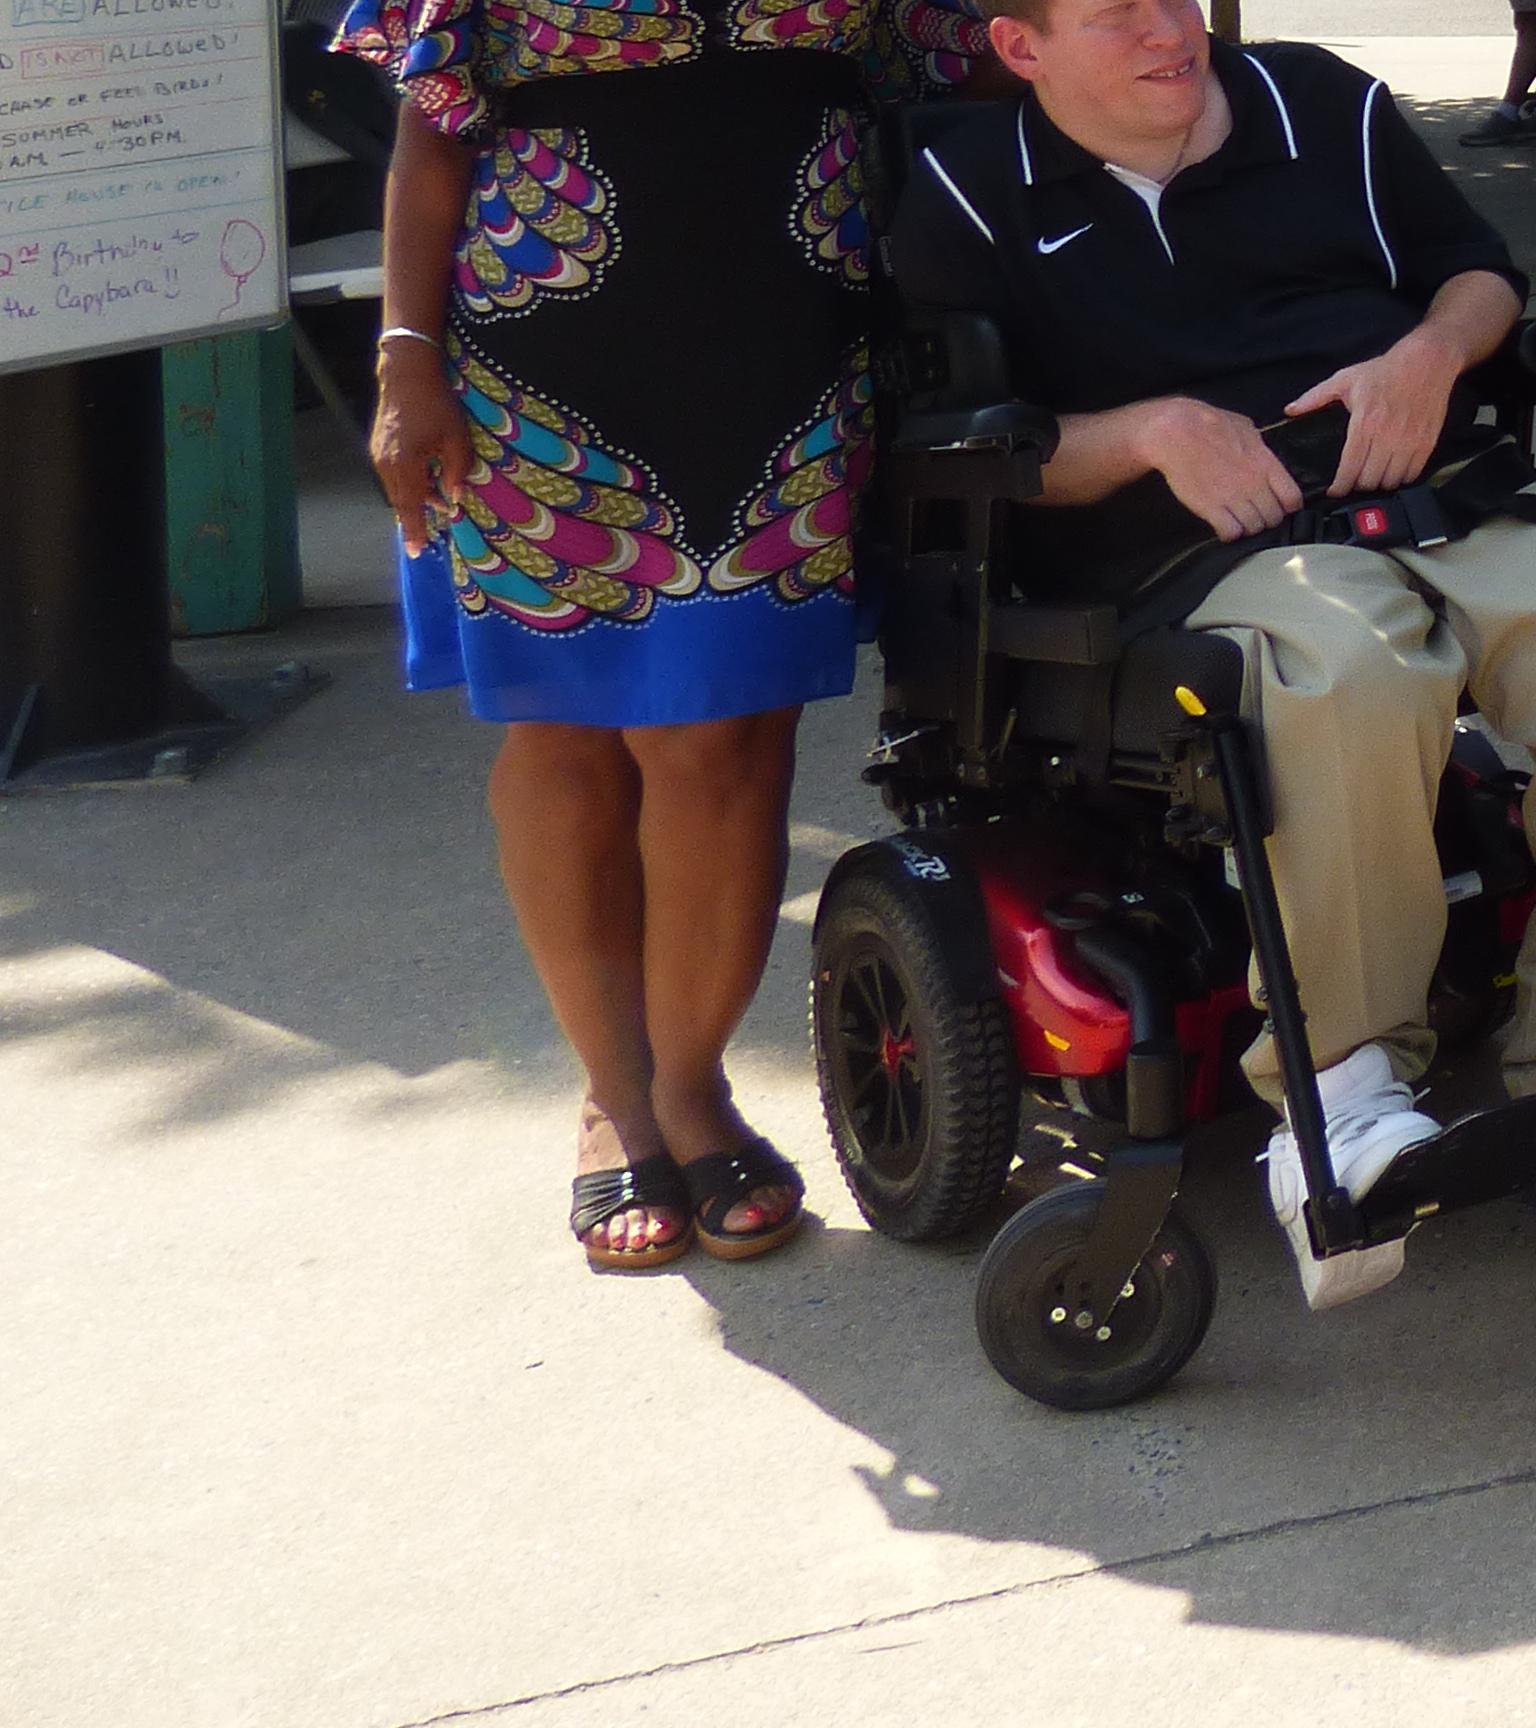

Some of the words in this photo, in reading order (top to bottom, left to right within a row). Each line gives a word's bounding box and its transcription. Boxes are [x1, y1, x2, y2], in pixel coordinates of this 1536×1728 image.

[2, 123, 94, 148] SUMMER
[112, 114, 164, 132] HOURS
[4, 297, 40, 320] the
